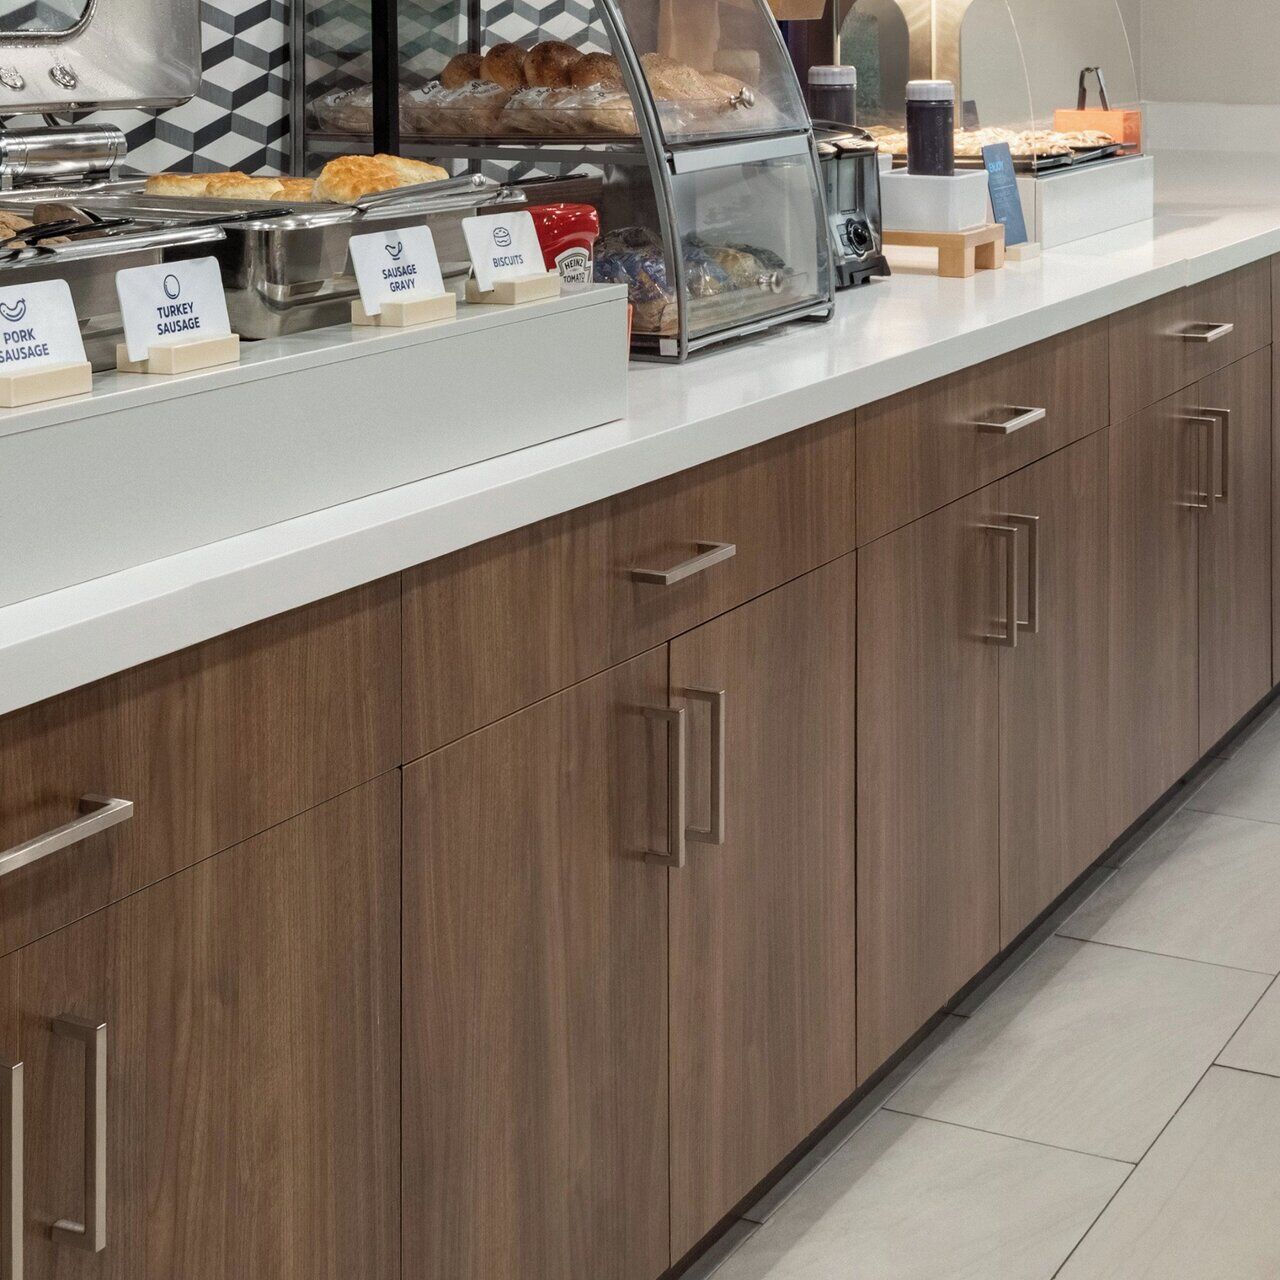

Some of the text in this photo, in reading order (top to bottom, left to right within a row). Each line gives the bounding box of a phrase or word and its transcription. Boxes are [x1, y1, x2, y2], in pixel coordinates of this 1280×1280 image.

[492, 253, 524, 269] BISCUITS
[564, 258, 584, 270] HEINZ
[381, 263, 418, 280] SAUSAGE
[389, 280, 416, 293] GRAVY
[156, 301, 194, 319] TURKEY
[156, 317, 201, 336] SAUSAGE
[3, 327, 36, 344] PORK
